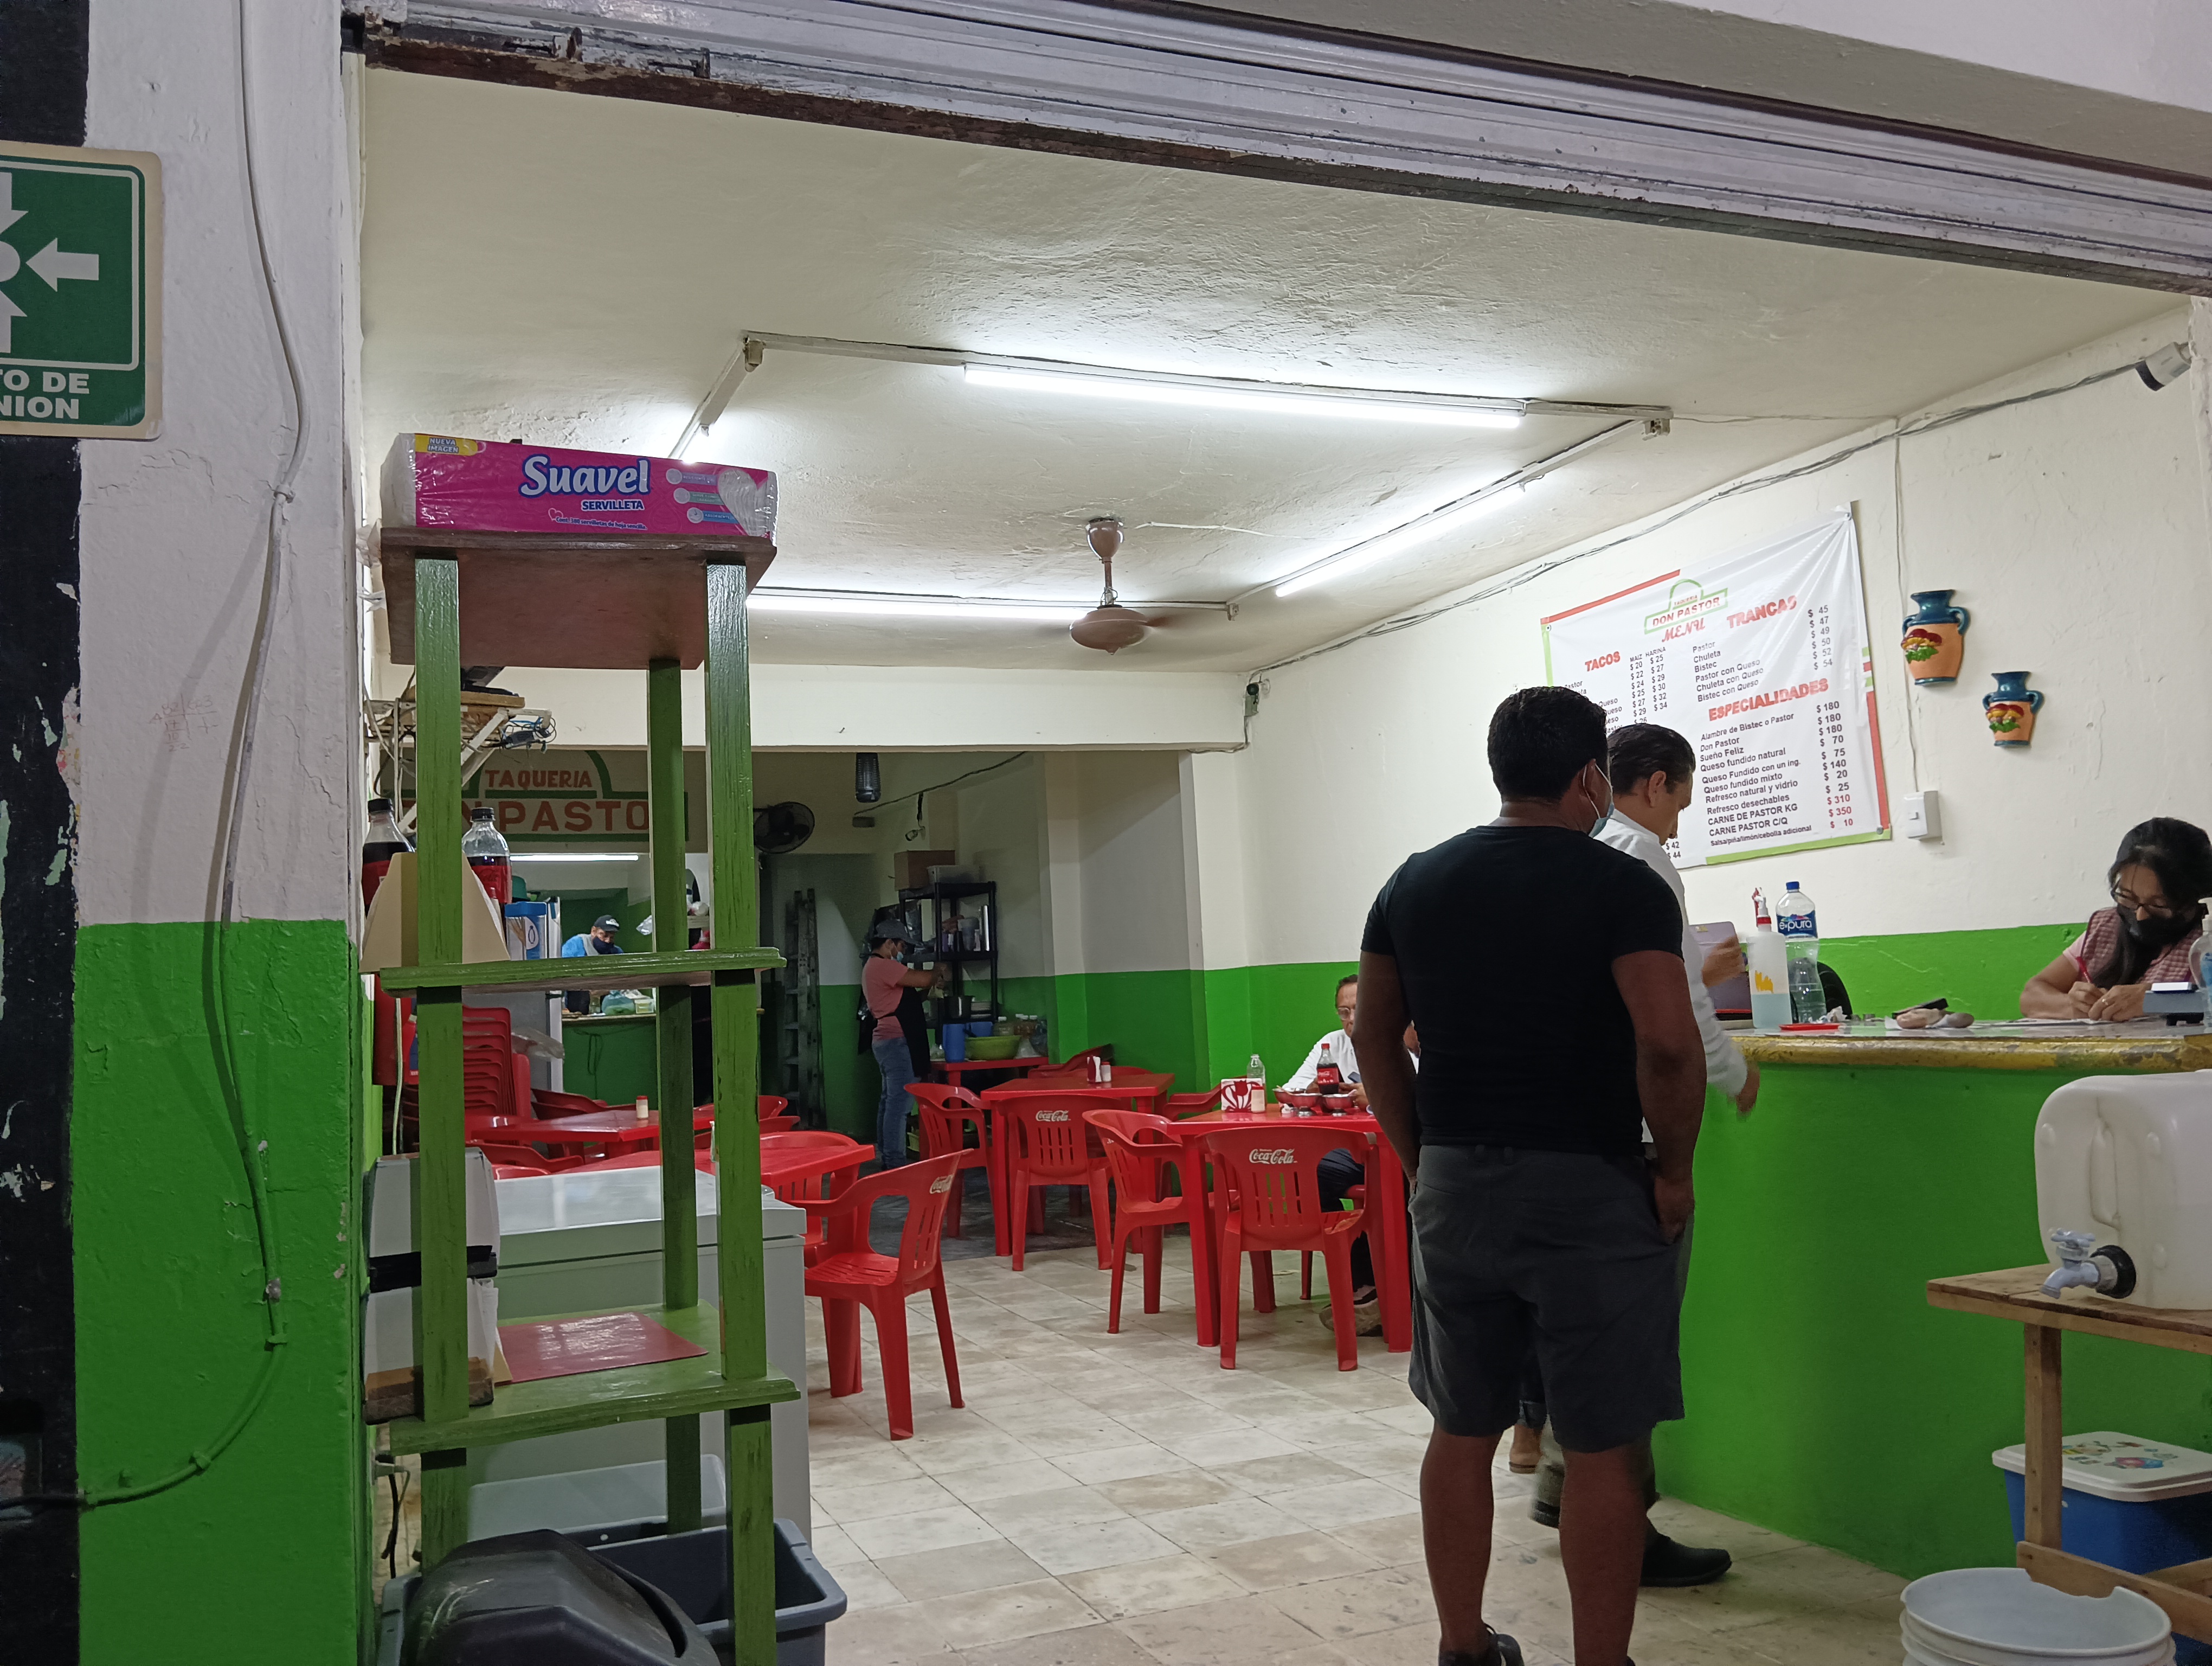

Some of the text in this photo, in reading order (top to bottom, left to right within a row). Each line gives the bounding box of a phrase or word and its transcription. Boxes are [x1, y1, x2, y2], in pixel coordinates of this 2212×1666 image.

[0, 369, 89, 394] O DE
[520, 456, 649, 496] Suavel
[582, 500, 644, 510] SERVILLETA
[1652, 597, 1720, 626] DON PASTOR
[1727, 595, 1797, 629] TRANCAS
[1662, 618, 1705, 643] MENU
[1693, 605, 1829, 653] Pastor $ 45
[1694, 616, 1829, 663] Chuleta $ 47
[1585, 651, 1621, 672] TACOS
[1630, 646, 1666, 662] MAIZ HARINA
[1636, 661, 1643, 670] 20
[1656, 654, 1663, 663] 25
[1695, 626, 1830, 672] Bistec $ 49
[1695, 671, 1719, 682] Pastor
[1737, 659, 1760, 671] Queso
[1812, 641, 1817, 649] $
[1636, 670, 1643, 678] 22
[1657, 664, 1664, 672] 27
[1696, 648, 1831, 691] Chuleta con Queso $ 52
[1697, 691, 1720, 702] Bistec
[1737, 680, 1759, 691] Queso
[1814, 662, 1818, 670] $
[1823, 658, 1832, 667] 54
[1639, 708, 1647, 716] 29
[1708, 678, 1829, 721] ESPECIALIDADES
[1700, 713, 1841, 752] Don Pastor $ 180
[1701, 729, 1727, 741] Alambre
[1739, 721, 1763, 731] Bistec
[1771, 714, 1794, 724] Pastor
[1817, 704, 1821, 713] $
[1823, 701, 1840, 711] 180
[1700, 724, 1842, 762] Sueño Feliz $ 180
[1700, 735, 1844, 772] Queso fundido natural $ 70
[485, 770, 592, 789] TAQUERIA
[1702, 774, 1727, 784] Queso
[1729, 767, 1759, 779] Fundido
[1822, 751, 1827, 760] $
[1834, 748, 1846, 757] 75
[1703, 759, 1847, 794] Queso fundido mixto $ 140
[1706, 770, 1848, 803] Refresco natural y vidrio $ 20
[1707, 782, 1849, 815] Refresco desechables $ 25
[499, 800, 650, 832] PASTO
[1708, 794, 1850, 825] CARNE DE PASTOR KG $ 310
[1709, 806, 1852, 836] CARNE PASTOR C/Q $ 350
[1783, 825, 1812, 835] adicional
[1830, 821, 1835, 829] $
[1844, 818, 1853, 826] 10
[1249, 1149, 1295, 1164] Coca-Cola
